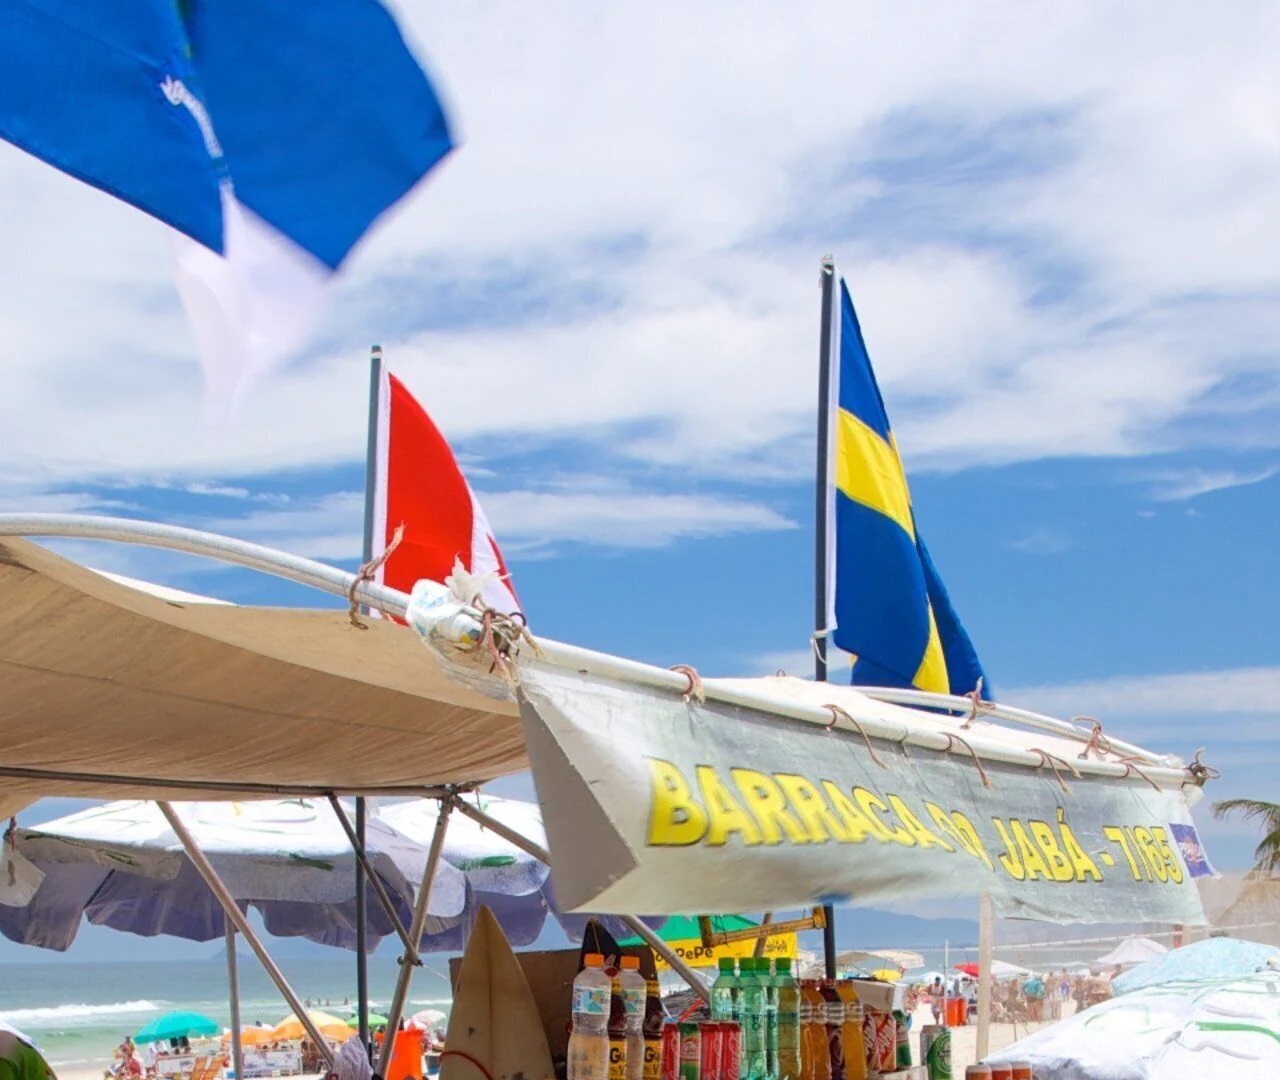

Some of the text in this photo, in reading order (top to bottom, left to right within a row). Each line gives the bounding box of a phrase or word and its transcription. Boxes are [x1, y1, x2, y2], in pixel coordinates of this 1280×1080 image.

[645, 755, 956, 852] BARRACA
[921, 799, 995, 872] DO
[990, 806, 1104, 883] JABÁ
